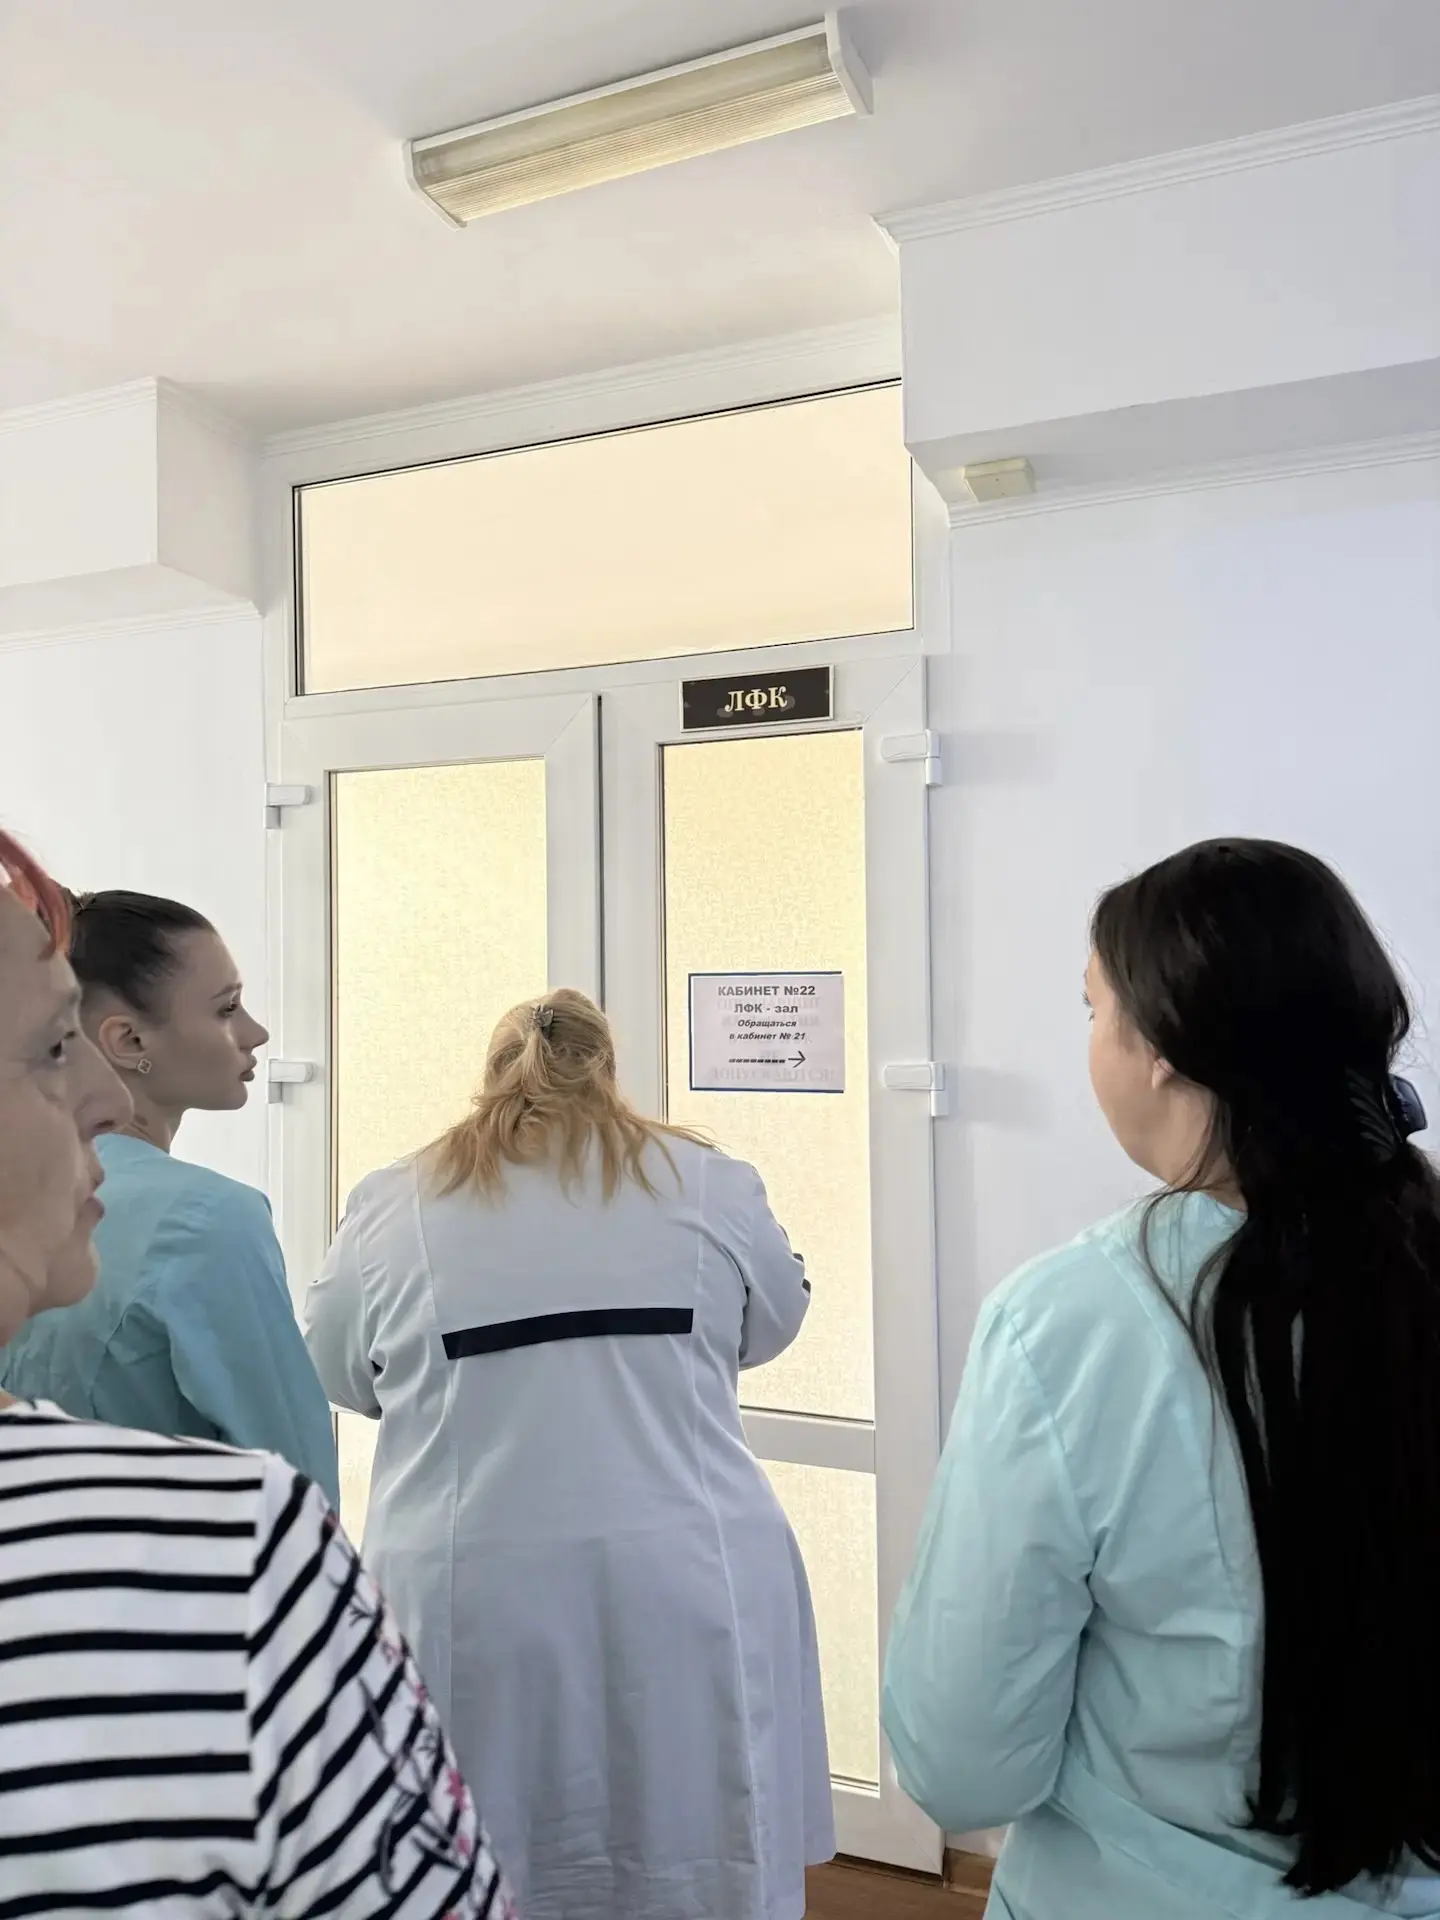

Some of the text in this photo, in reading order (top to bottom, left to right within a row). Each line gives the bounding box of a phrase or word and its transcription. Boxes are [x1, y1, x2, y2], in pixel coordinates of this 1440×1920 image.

[724, 686, 788, 712] ЛФК
[718, 985, 816, 996] КАБИНЕТ №22
[734, 1003, 763, 1013] ЛФК
[737, 1019, 797, 1028] Обращаться
[737, 1031, 777, 1040] кабинет
[779, 1032, 792, 1040] №
[794, 1032, 806, 1040] 21
